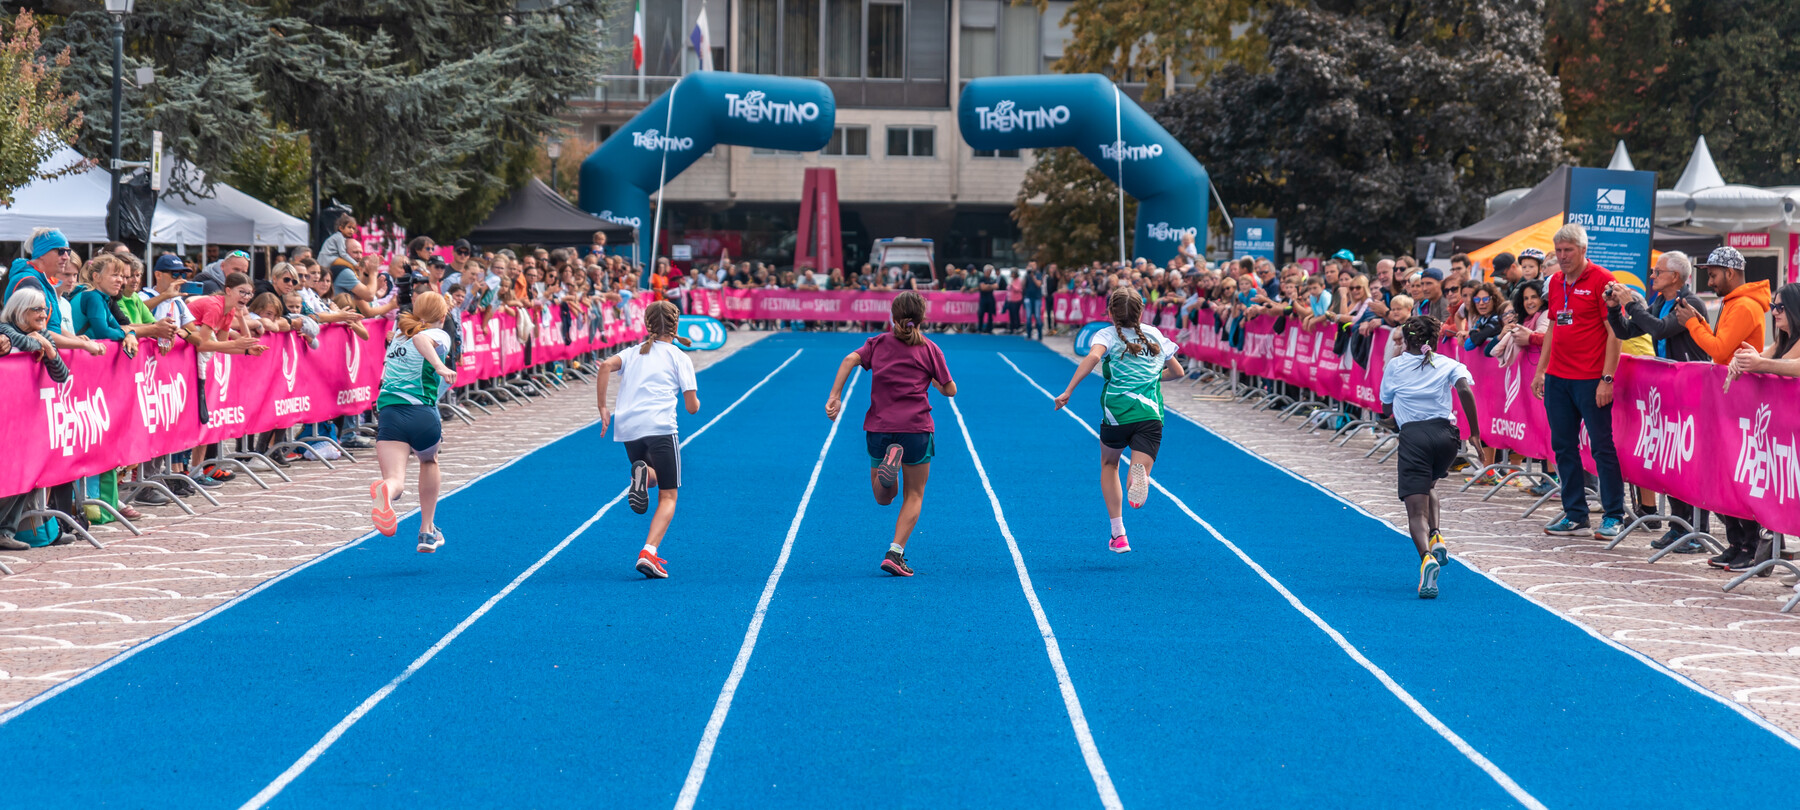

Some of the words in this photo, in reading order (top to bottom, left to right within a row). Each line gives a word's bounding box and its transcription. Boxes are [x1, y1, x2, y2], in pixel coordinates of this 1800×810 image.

[724, 93, 819, 124] TRENTINO
[975, 104, 1070, 132] TRENTINO
[632, 131, 693, 151] TRENTINO
[1099, 143, 1163, 161] TRENTINO
[591, 213, 641, 228] NTINO
[1147, 223, 1198, 241] TRENTINO
[1568, 213, 1594, 225] PISTA
[1597, 214, 1607, 226] DI
[1609, 215, 1650, 228] ATLETICA
[1730, 234, 1767, 246] INFOPOINT
[135, 371, 187, 433] TRENTINO
[40, 387, 110, 456] TRENTINO
[1633, 399, 1695, 474] TRENTINO
[1734, 416, 1800, 504] TRENTIN
